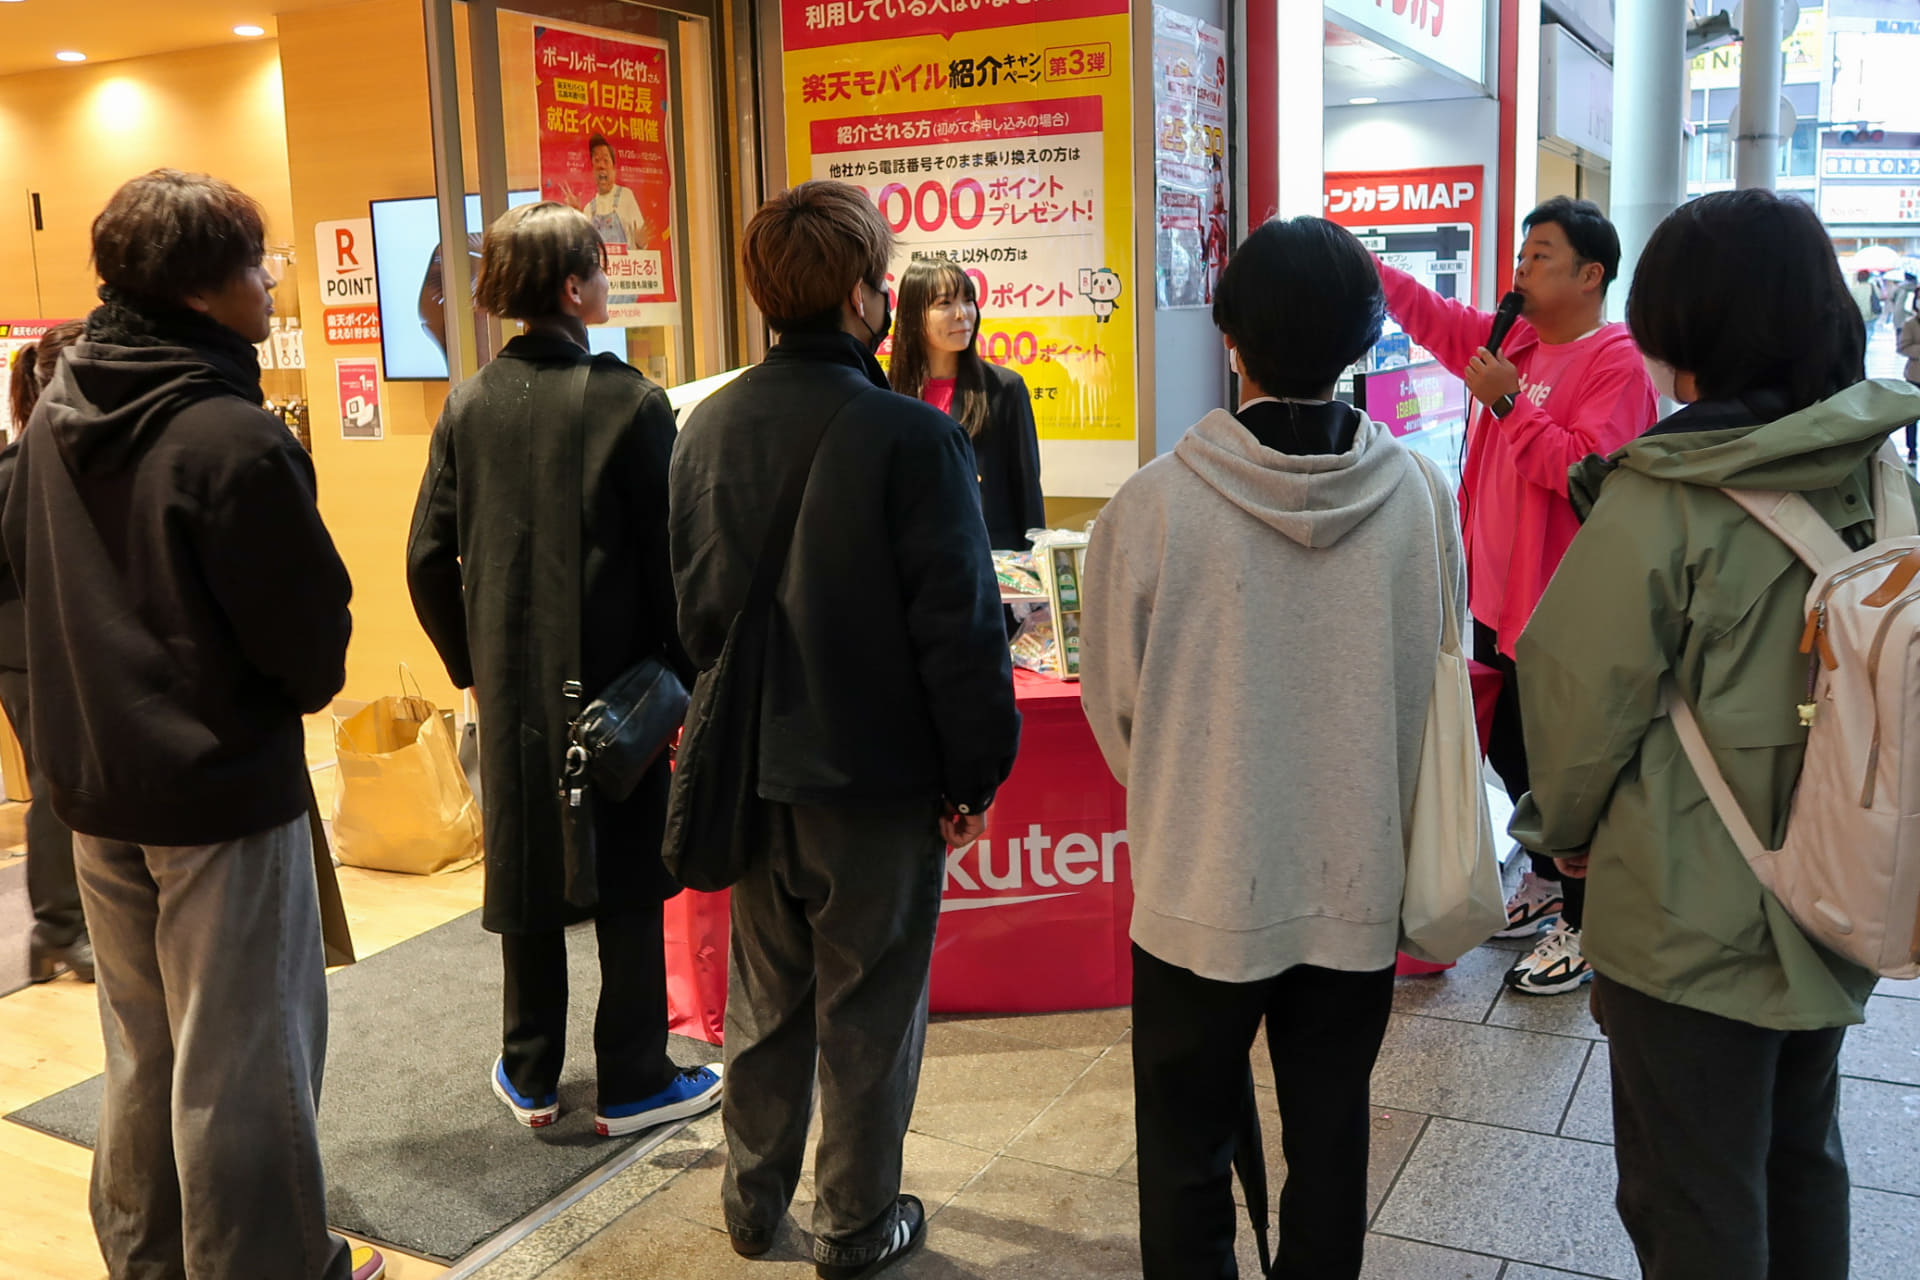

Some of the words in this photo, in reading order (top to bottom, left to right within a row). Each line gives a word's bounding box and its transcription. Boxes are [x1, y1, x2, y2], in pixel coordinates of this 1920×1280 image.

[1050, 49, 1105, 76] 第3弾
[590, 80, 652, 114] 1日店長
[546, 106, 659, 142] 就任イベント開催
[829, 147, 1081, 178] 他社から電話番号そのまま乗り換えの方は
[989, 175, 1063, 201] ポイント
[1324, 182, 1475, 213] ンカラMAP
[989, 199, 1093, 226] プレゼント!
[327, 277, 373, 297] POINT
[992, 282, 1074, 308] ポイント
[327, 312, 378, 327] 楽天ポイント
[1040, 343, 1107, 364] ポイント
